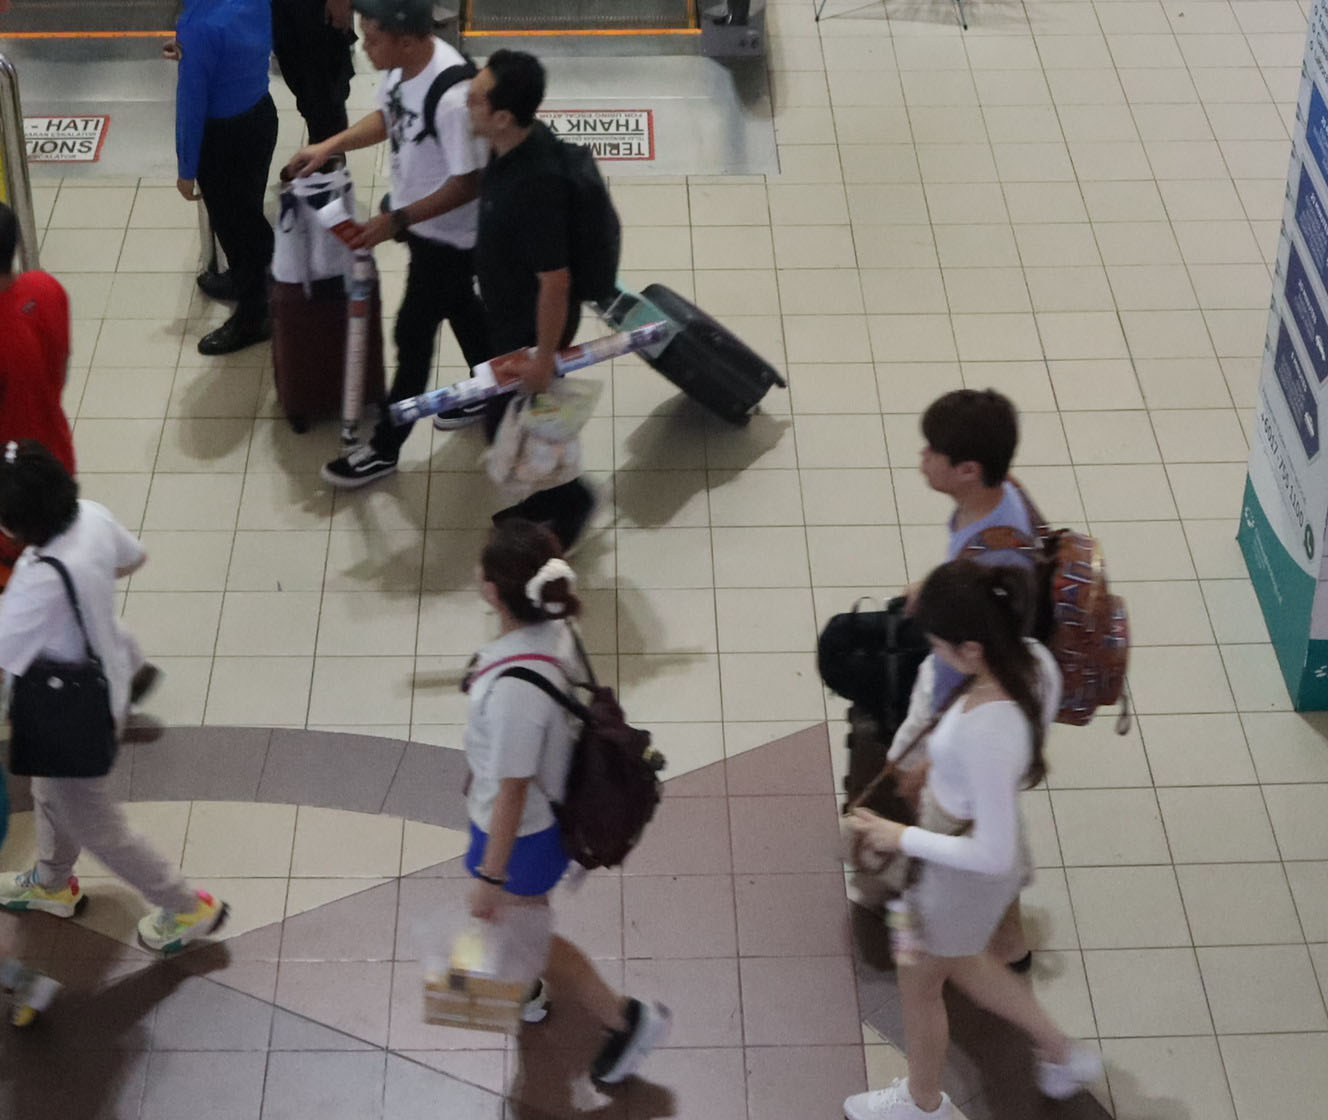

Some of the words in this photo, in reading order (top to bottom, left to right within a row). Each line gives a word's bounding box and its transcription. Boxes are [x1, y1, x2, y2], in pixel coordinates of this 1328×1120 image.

[46, 119, 100, 131] HATI
[567, 119, 644, 131] THANK
[584, 142, 645, 156] TERIM
